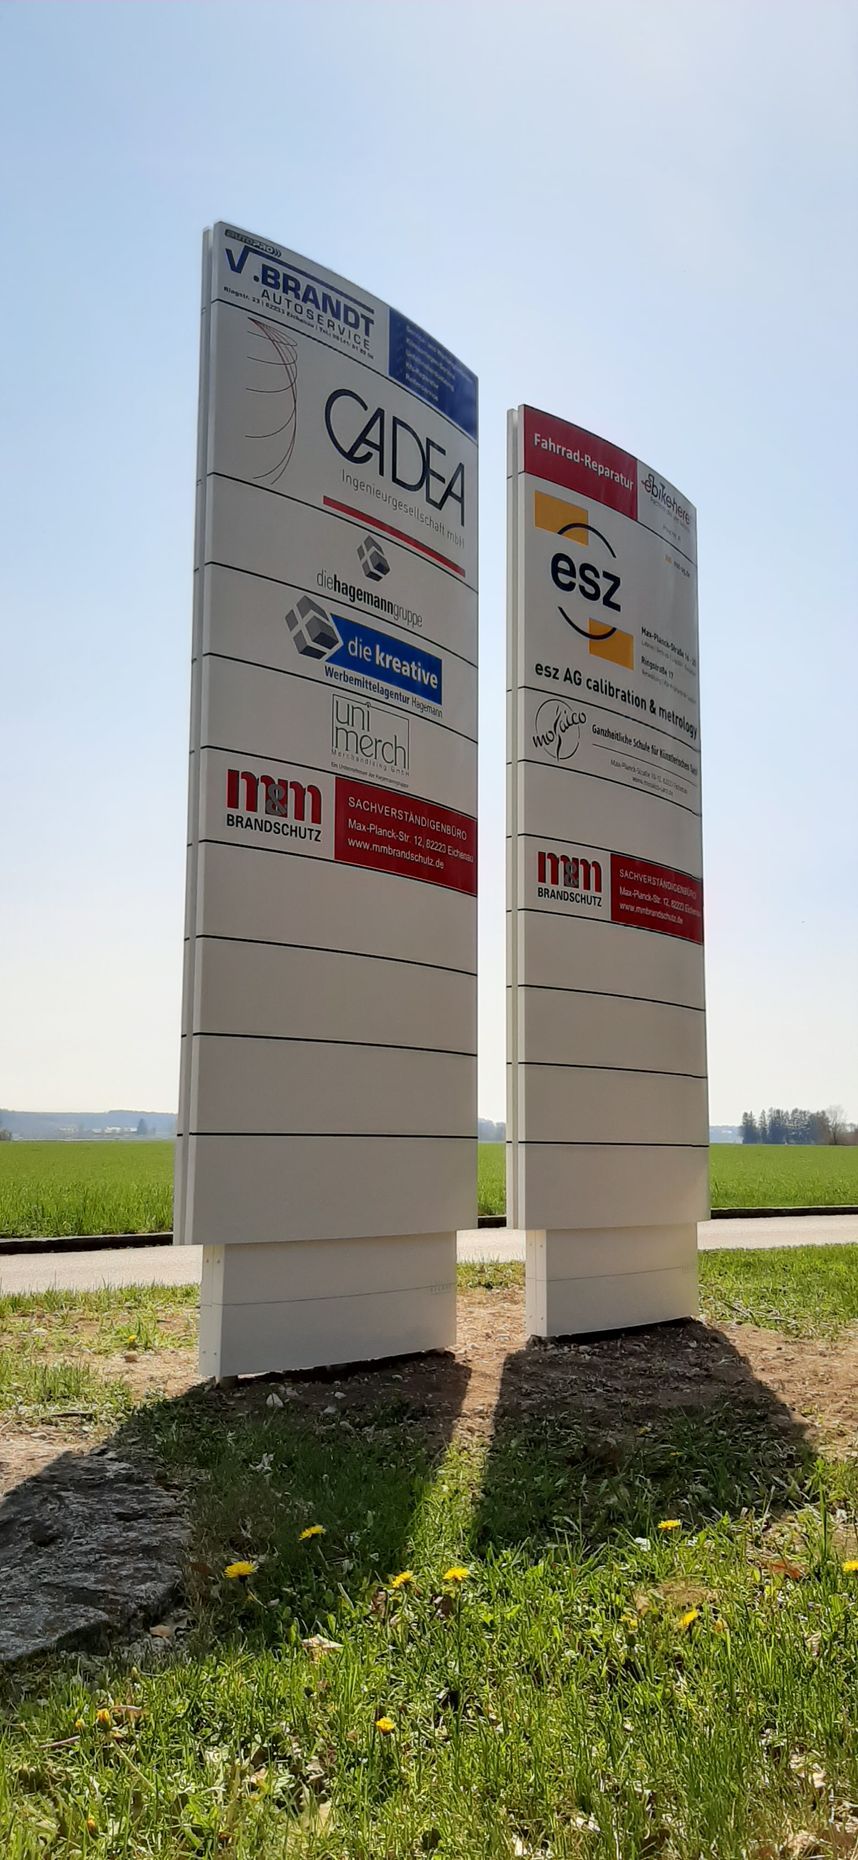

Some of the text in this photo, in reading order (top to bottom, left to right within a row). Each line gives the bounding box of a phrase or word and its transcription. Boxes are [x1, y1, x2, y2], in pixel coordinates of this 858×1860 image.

[261, 289, 371, 351] AUTOSERVICE
[325, 389, 464, 527] CADEA
[533, 432, 635, 492] Fahrrad-Reparatur
[342, 469, 445, 537] Ingenieurgesellschaft
[316, 569, 423, 628] diehagemanngruppe
[551, 552, 621, 612] esz
[324, 665, 410, 705] Werbemittelagentur
[348, 637, 438, 689] die kreative
[335, 700, 370, 732] uni
[535, 663, 560, 680] esz
[563, 667, 582, 687] AG
[586, 676, 647, 709] calibration
[649, 699, 657, 714] &
[658, 706, 697, 740] metrology
[335, 727, 407, 768] merch
[592, 724, 632, 746] Ganzheitliche
[226, 814, 322, 843] BRANDSCHUTZ
[348, 796, 467, 841] SACHVERSTÄNDIGENBÜRO
[348, 819, 411, 843] Max-Planck-Str.
[348, 837, 445, 869] www.mmbrandschutz.de
[537, 887, 602, 908] BRANDSCHUTZ
